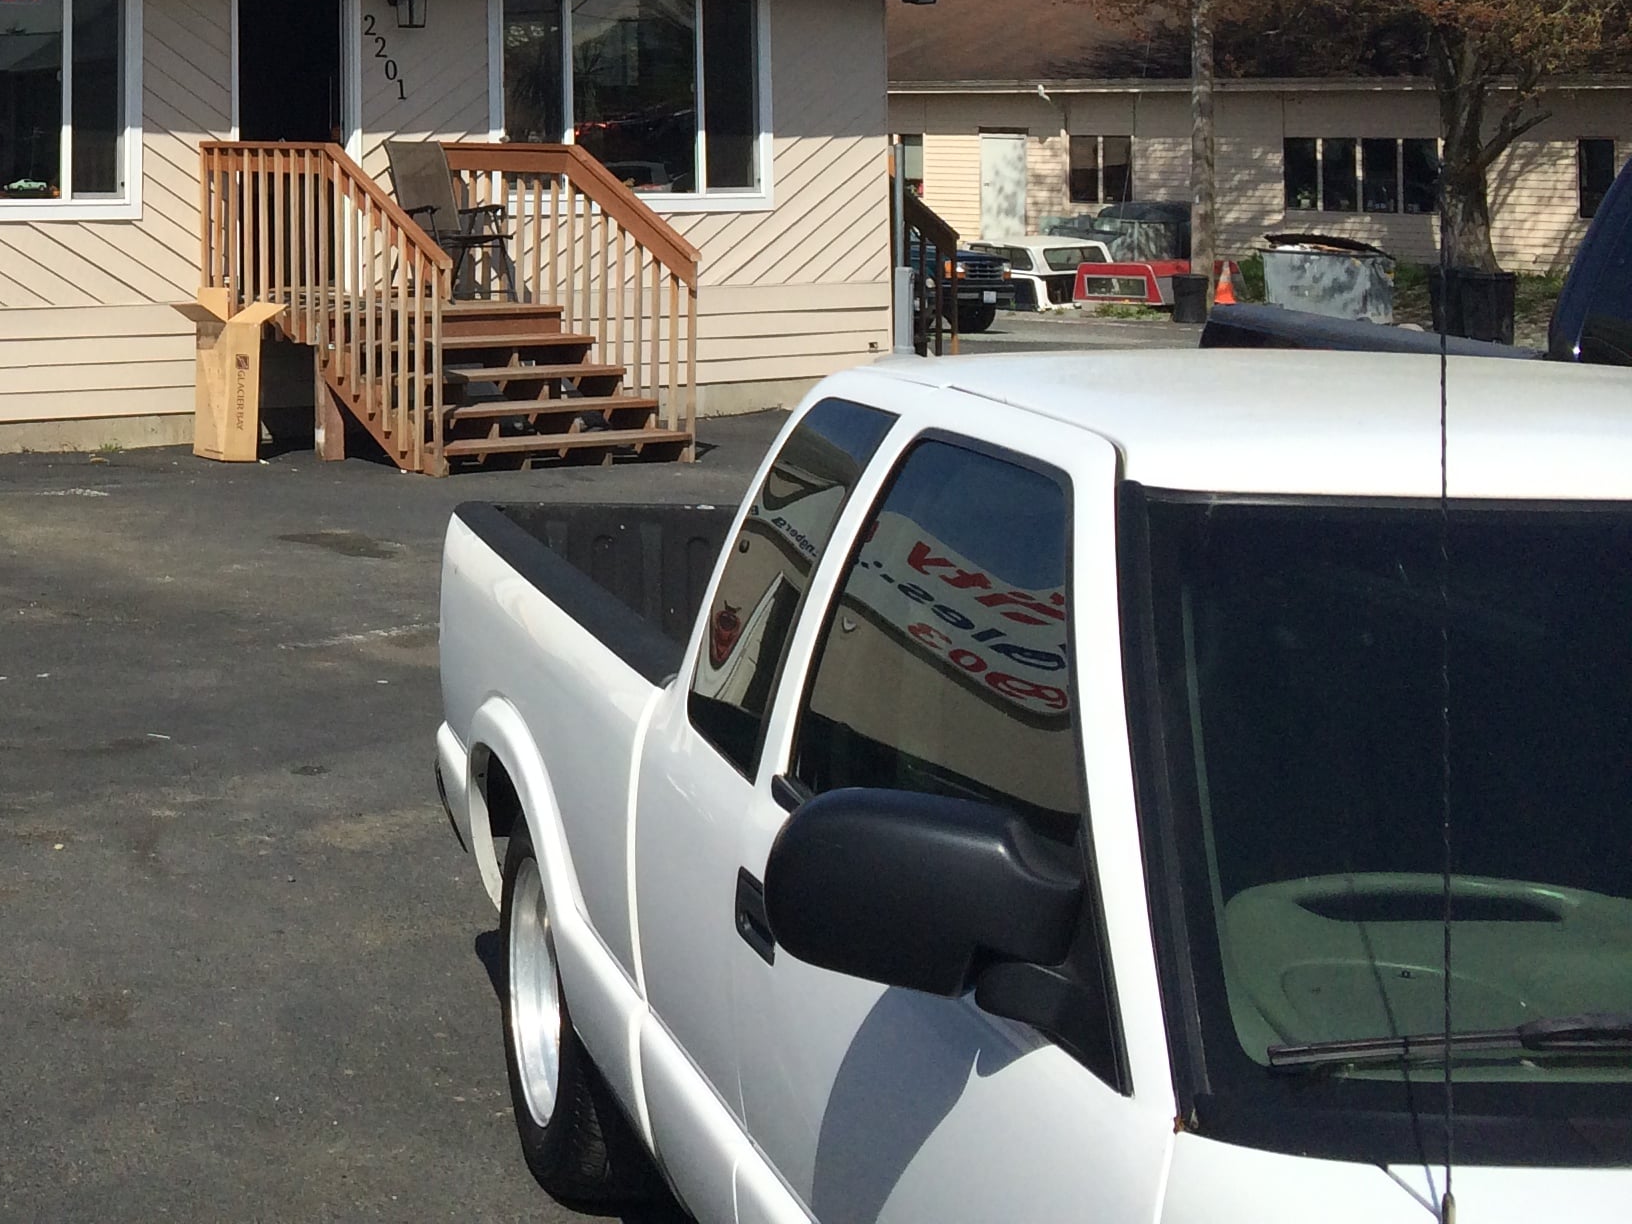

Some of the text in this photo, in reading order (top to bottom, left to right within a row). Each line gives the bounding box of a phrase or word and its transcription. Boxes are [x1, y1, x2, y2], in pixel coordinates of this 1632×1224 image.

[364, 14, 407, 100] 2201
[235, 369, 247, 431] GLACIER BAY
